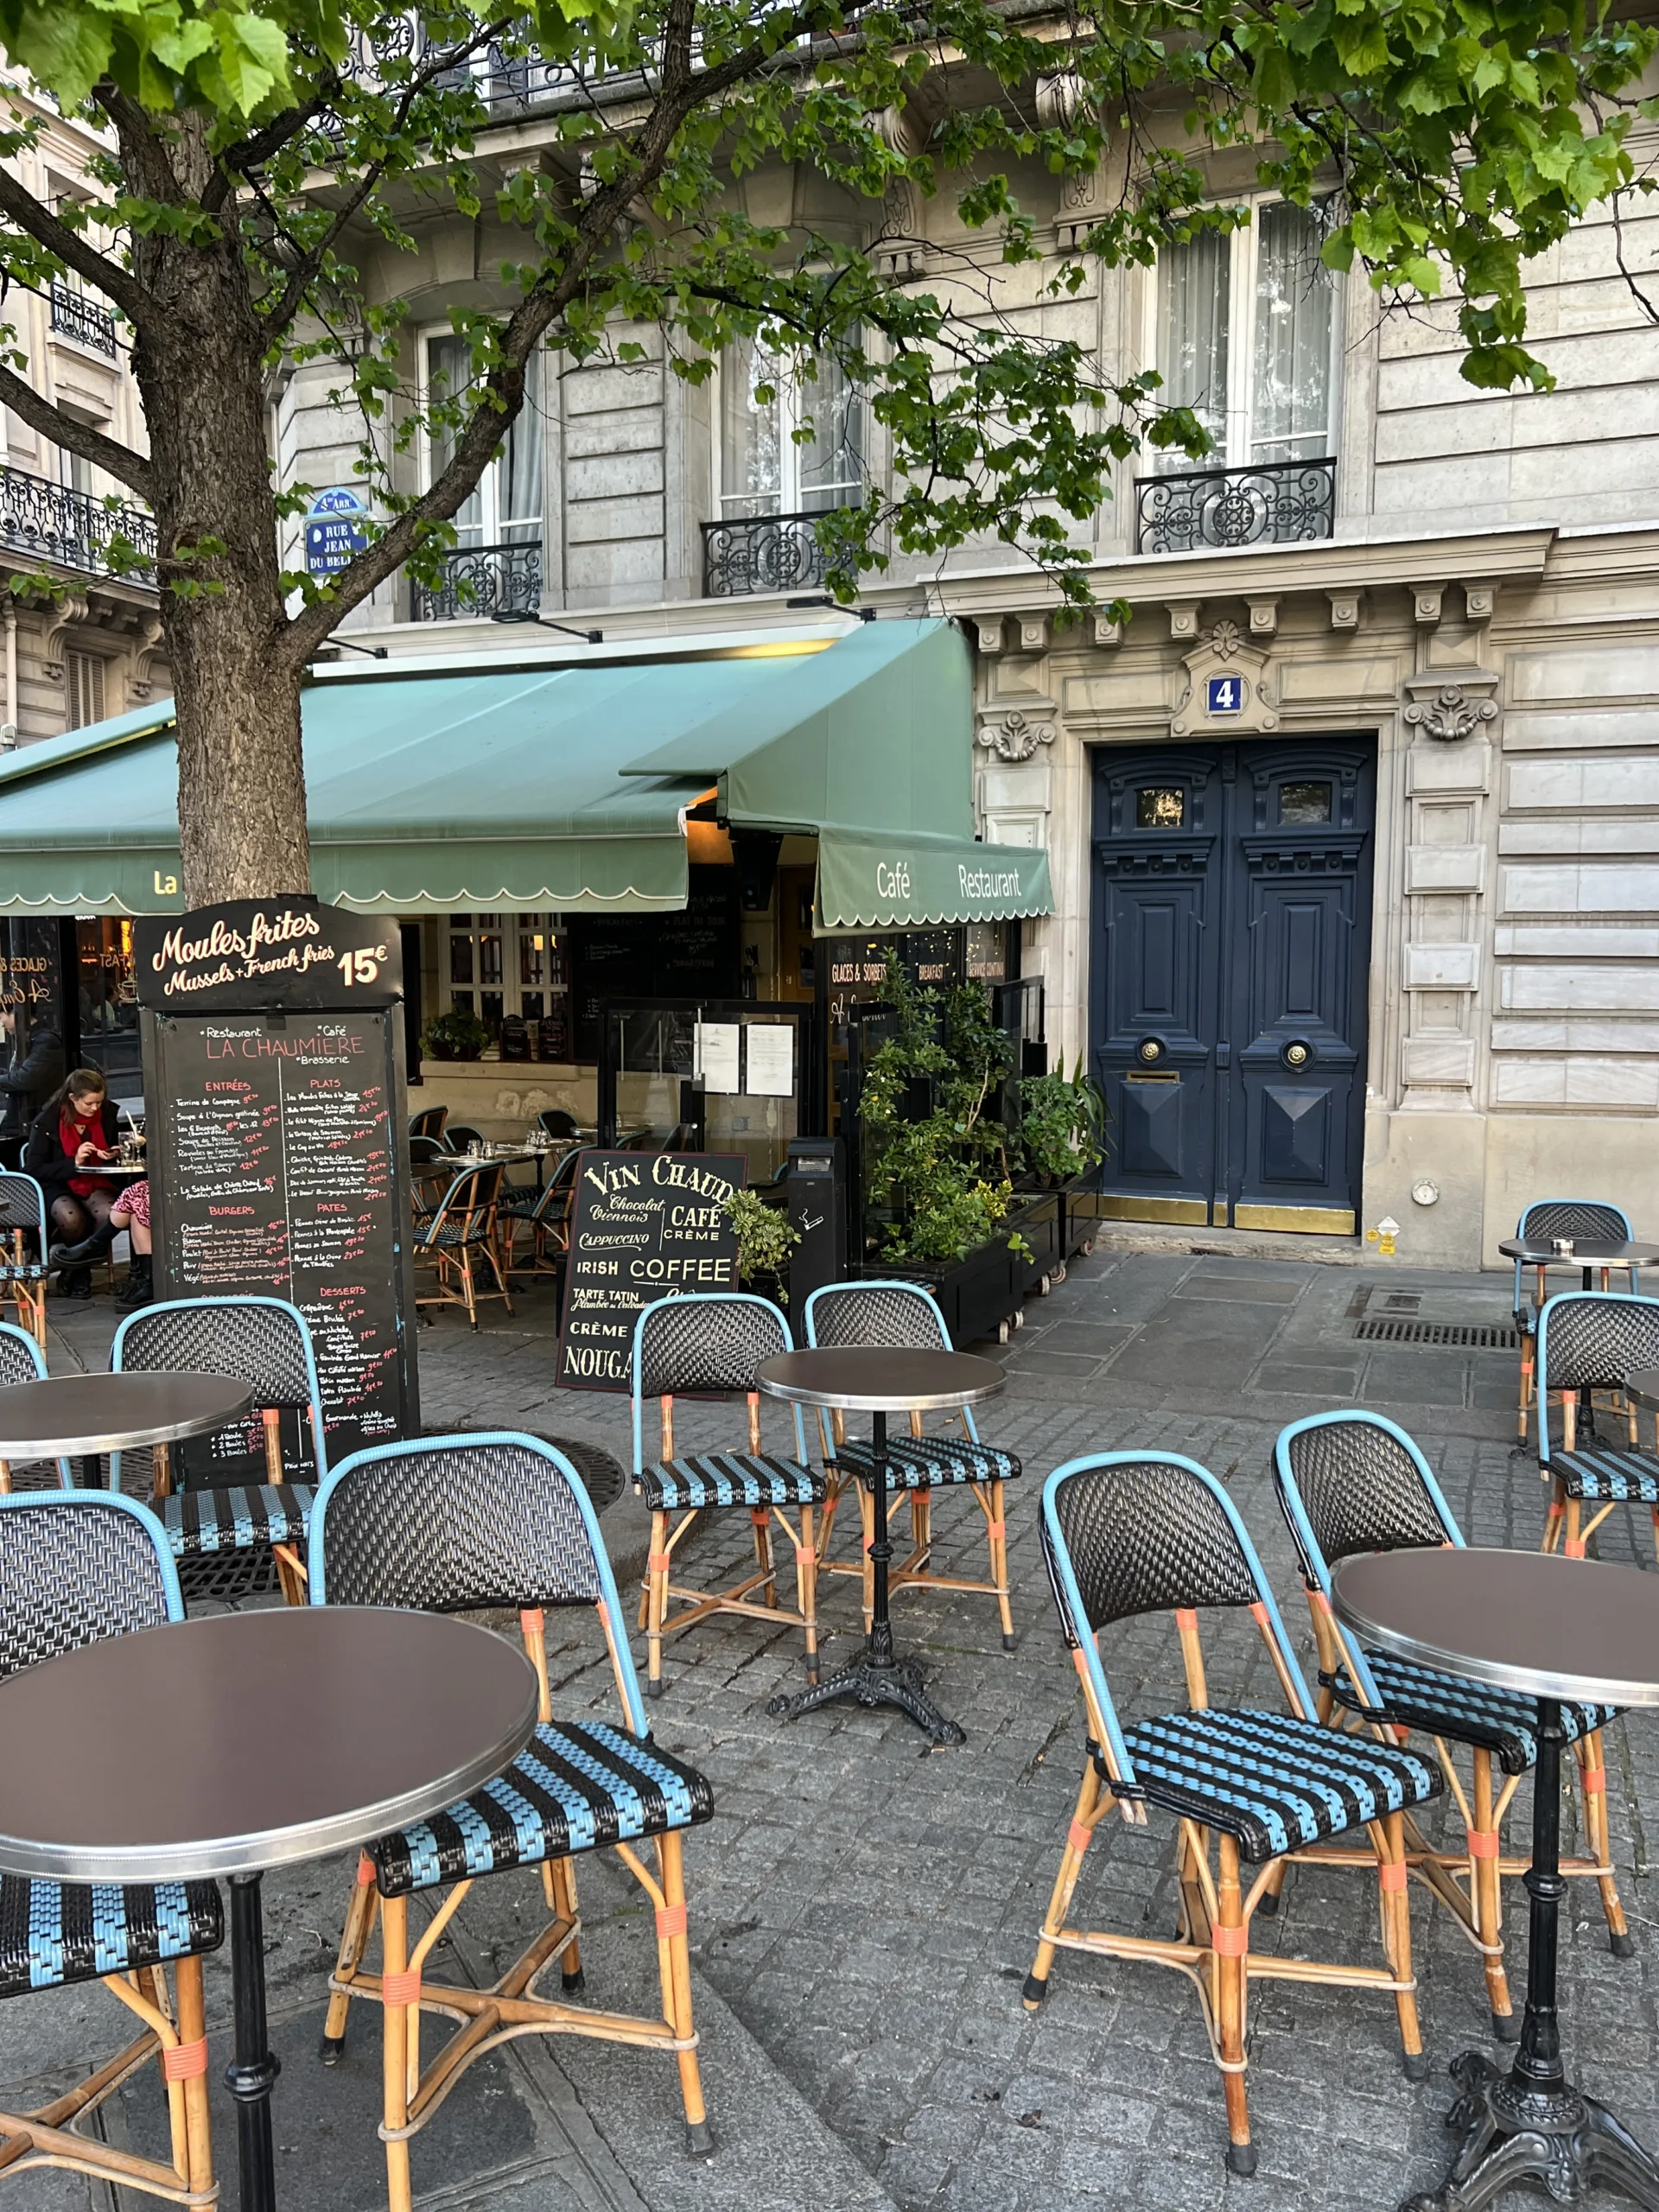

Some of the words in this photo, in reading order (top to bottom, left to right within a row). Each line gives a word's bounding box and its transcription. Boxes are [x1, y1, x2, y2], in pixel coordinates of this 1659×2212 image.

[326, 524, 348, 538] RUE
[324, 539, 352, 553] JEAN
[309, 557, 323, 569] DU
[1216, 681, 1234, 708] 4
[154, 870, 177, 894] La
[876, 861, 911, 899] Café
[958, 864, 1022, 898] Restaurant
[153, 919, 246, 972] Moules
[241, 910, 321, 959] frites
[164, 962, 234, 996] Mussels
[244, 948, 299, 978] French
[296, 943, 335, 973] fries
[337, 944, 389, 987] 15€
[832, 963, 854, 983] GLACES
[855, 963, 861, 982] &
[863, 963, 887, 982] SORBETS
[919, 963, 944, 981] BREAKFAST
[969, 962, 986, 977] SERVICE
[207, 1027, 262, 1038] Restaurant
[322, 1025, 346, 1036] Café
[207, 1039, 235, 1058] LA
[301, 1056, 350, 1065] Brasserie
[206, 1078, 251, 1090] ENTRÉES
[310, 1079, 341, 1088] PLATS
[584, 1161, 641, 1196] VIN
[652, 1155, 734, 1205] CHAUD
[208, 1205, 255, 1216] BURGERS
[317, 1203, 347, 1212] PATES
[609, 1194, 666, 1211] Chocolat
[589, 1205, 649, 1223] Viennois
[671, 1204, 721, 1228] CAFÉ
[579, 1232, 650, 1249] CAPPUCCINO
[664, 1229, 720, 1241] CRÈME
[576, 1262, 619, 1275] IRISH
[630, 1258, 731, 1282] COFFEE
[320, 1287, 366, 1297] DESSERTS
[573, 1287, 606, 1300] TARTE
[608, 1290, 639, 1302] TATIN
[569, 1321, 629, 1338] CRÈME
